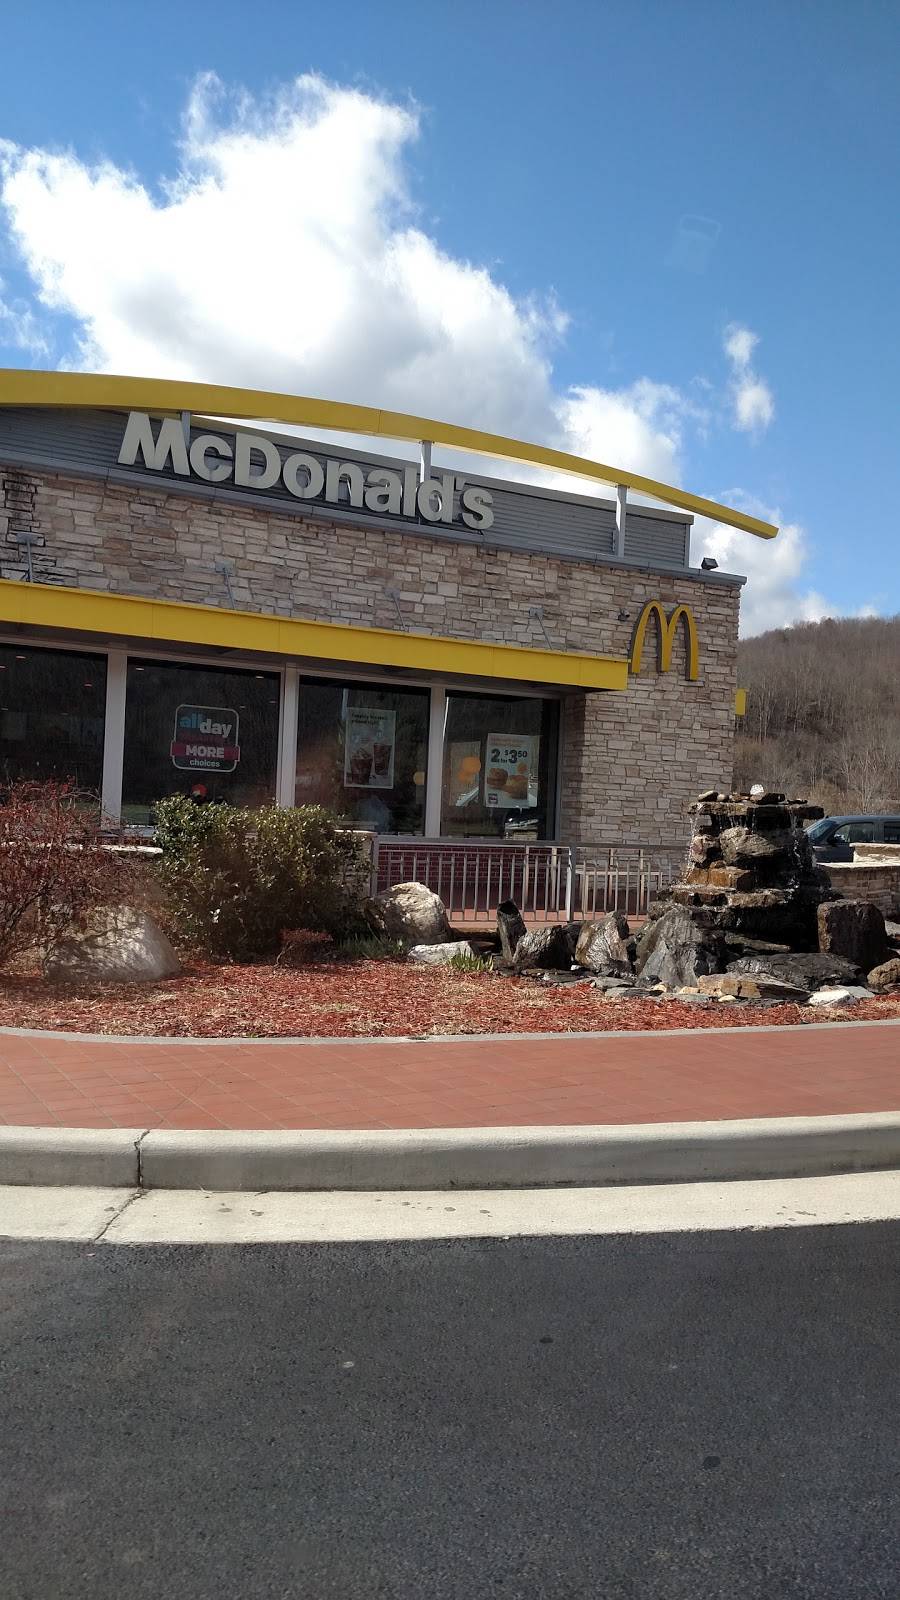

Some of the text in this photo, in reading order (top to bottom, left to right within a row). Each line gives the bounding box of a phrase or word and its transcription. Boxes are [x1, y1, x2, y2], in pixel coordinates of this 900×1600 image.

[117, 411, 495, 530] McDonald's
[200, 719, 232, 738] day
[185, 744, 225, 758] MORE
[490, 748, 501, 763] 2
[189, 759, 220, 767] choices
